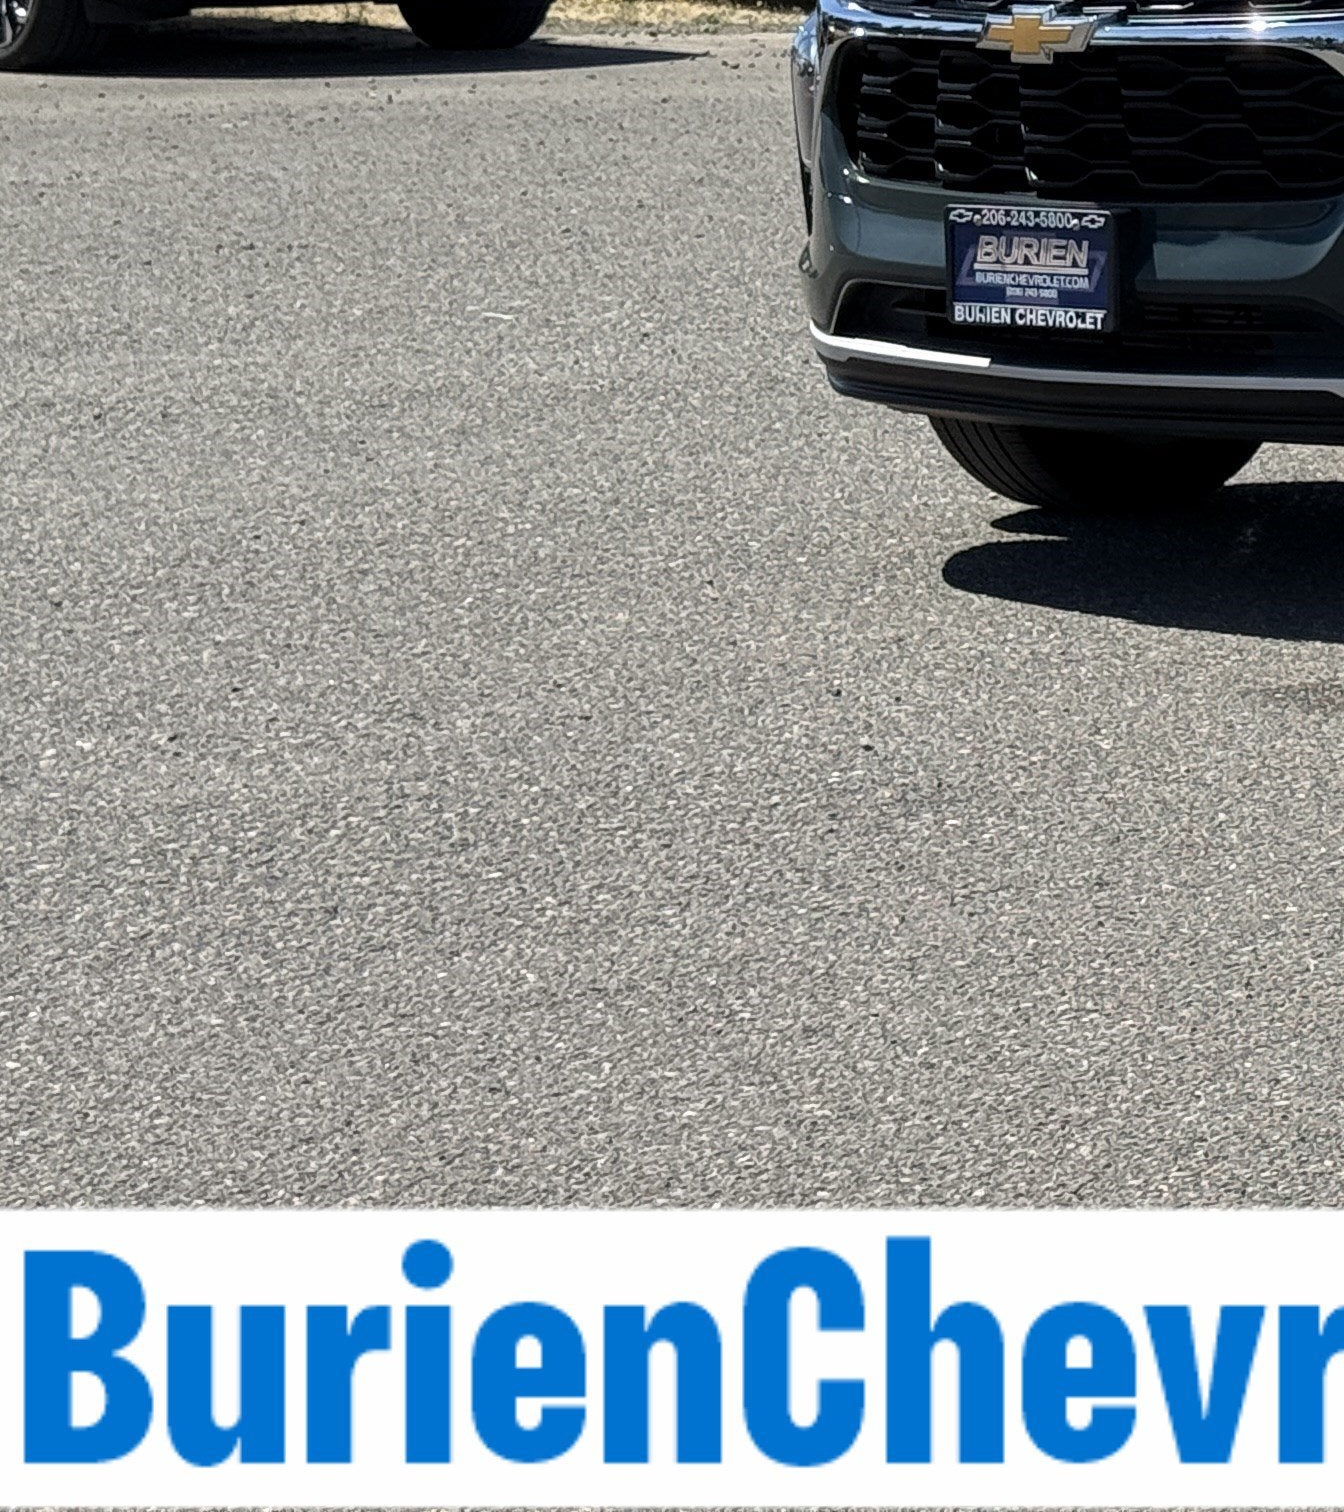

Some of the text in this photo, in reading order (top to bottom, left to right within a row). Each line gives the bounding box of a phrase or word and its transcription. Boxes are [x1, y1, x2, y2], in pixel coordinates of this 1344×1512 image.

[976, 235, 1090, 268] BURIEN
[974, 271, 1090, 289] BURIENCHEVROLET.COM
[1015, 308, 1105, 330] CHEVROLET
